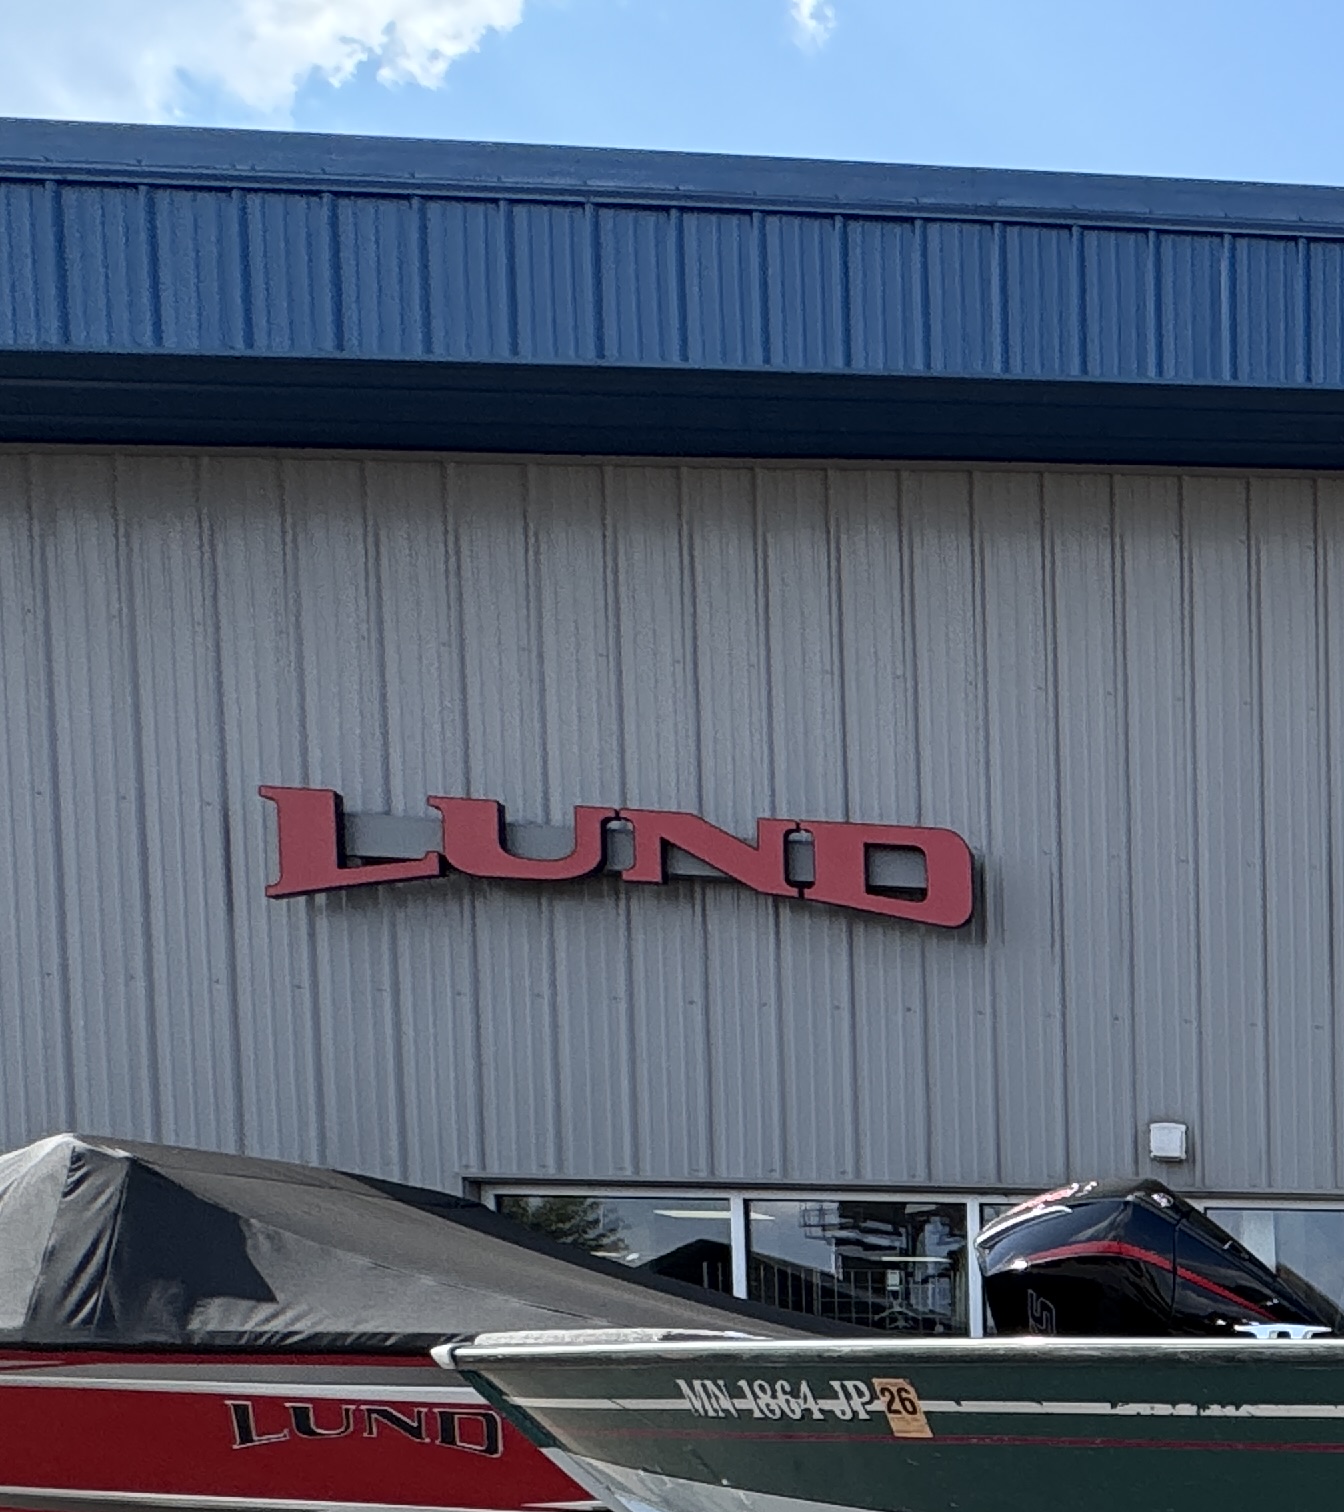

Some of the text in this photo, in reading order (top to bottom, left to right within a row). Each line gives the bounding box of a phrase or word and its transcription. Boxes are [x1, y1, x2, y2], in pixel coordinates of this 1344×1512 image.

[259, 784, 975, 929] LUND
[675, 1378, 872, 1421] MN 1864 JP
[880, 1386, 918, 1416] 26
[225, 1400, 503, 1458] LUND
